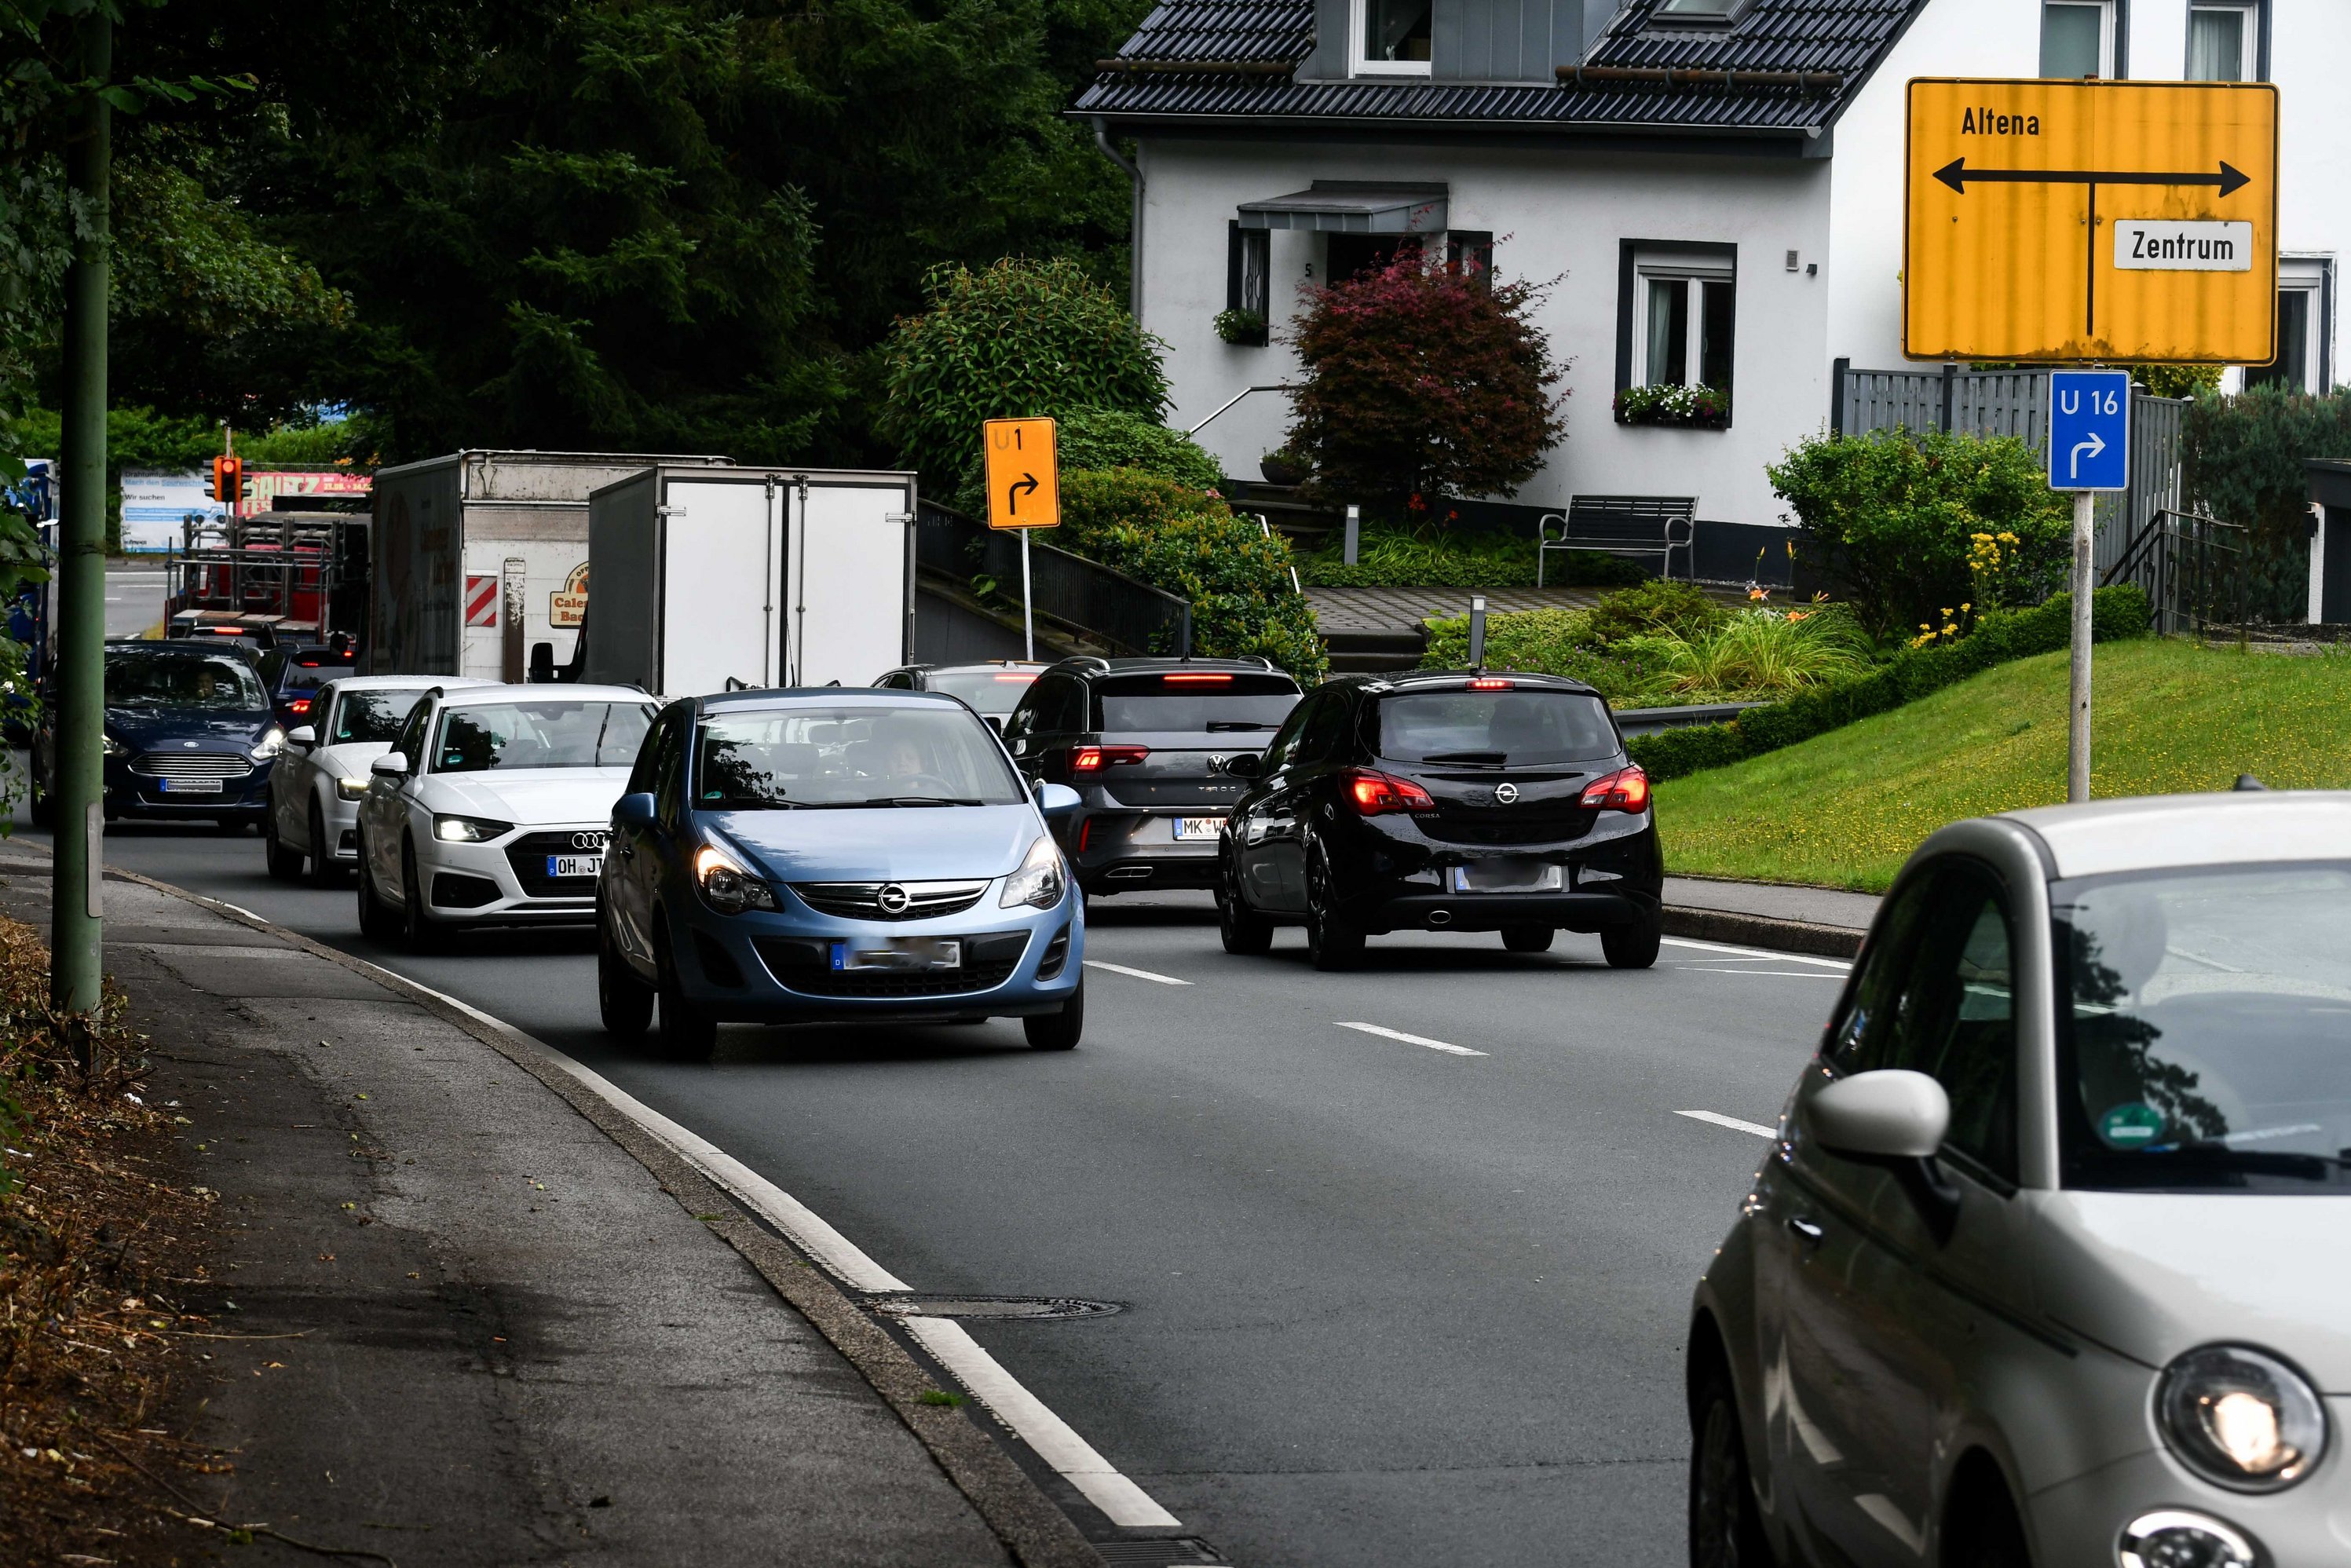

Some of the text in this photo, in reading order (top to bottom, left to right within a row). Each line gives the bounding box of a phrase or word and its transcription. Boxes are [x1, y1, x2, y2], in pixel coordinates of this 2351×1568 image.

[1962, 107, 2039, 135] Altena
[2133, 231, 2233, 260] Zentrum
[1305, 263, 1311, 277] 5
[2061, 389, 2118, 415] U 16
[1015, 428, 1022, 450] 1
[1183, 821, 1202, 834] MK
[558, 859, 576, 873] OH
